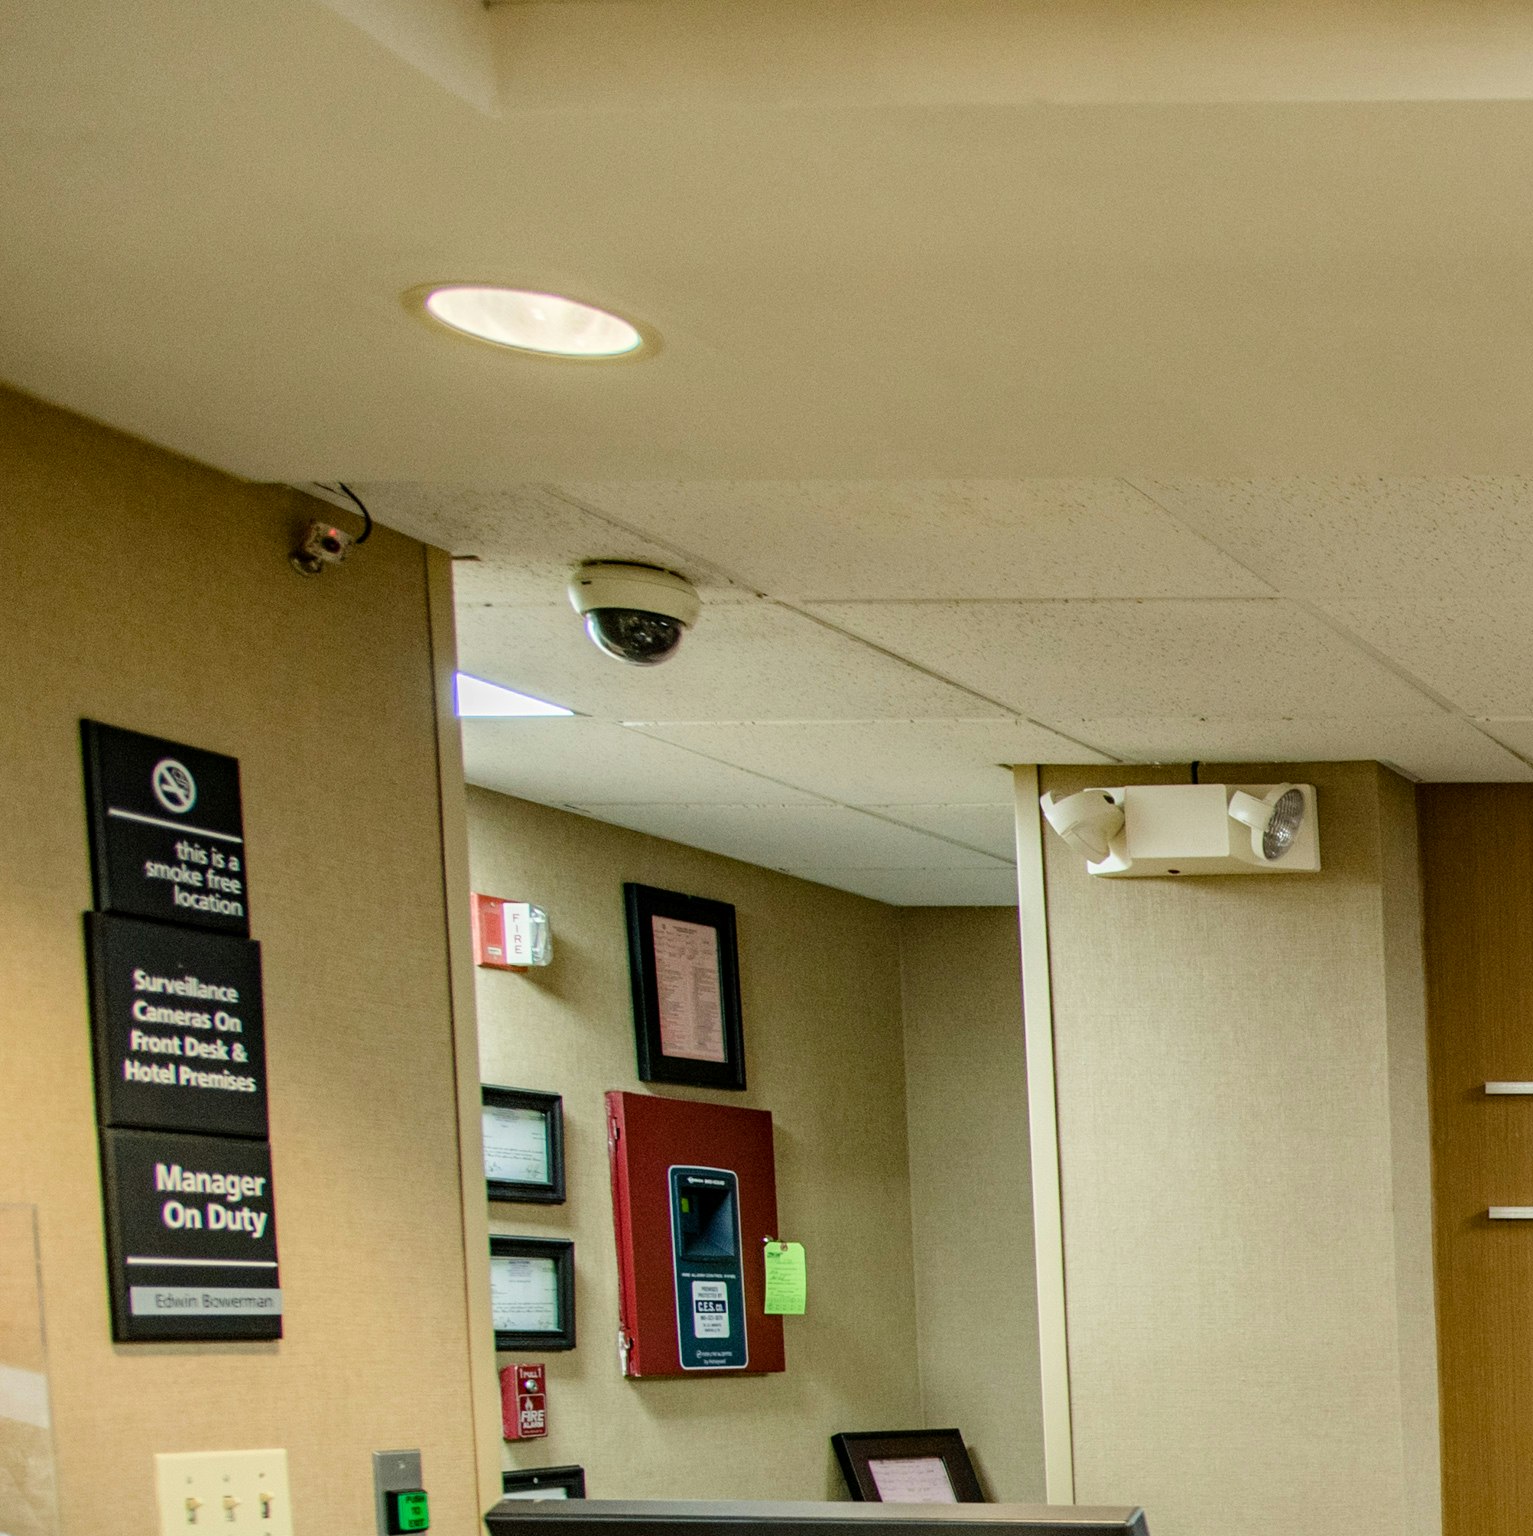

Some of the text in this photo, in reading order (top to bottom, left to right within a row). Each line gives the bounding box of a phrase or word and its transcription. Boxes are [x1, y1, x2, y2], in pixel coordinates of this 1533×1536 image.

[175, 840, 240, 871] this is a
[146, 861, 241, 894] smoke free
[174, 884, 244, 916] location
[512, 914, 522, 954] FIRE
[133, 968, 239, 1003] Surveillance
[132, 1000, 242, 1032] Cameras On
[131, 1029, 248, 1062] Front Desk &
[125, 1059, 256, 1092] Hotel Premises
[156, 1163, 266, 1202] Manager
[163, 1200, 268, 1238] On Duty
[155, 1294, 273, 1308] Edwin Bowerman
[521, 1410, 544, 1422] FIRE
